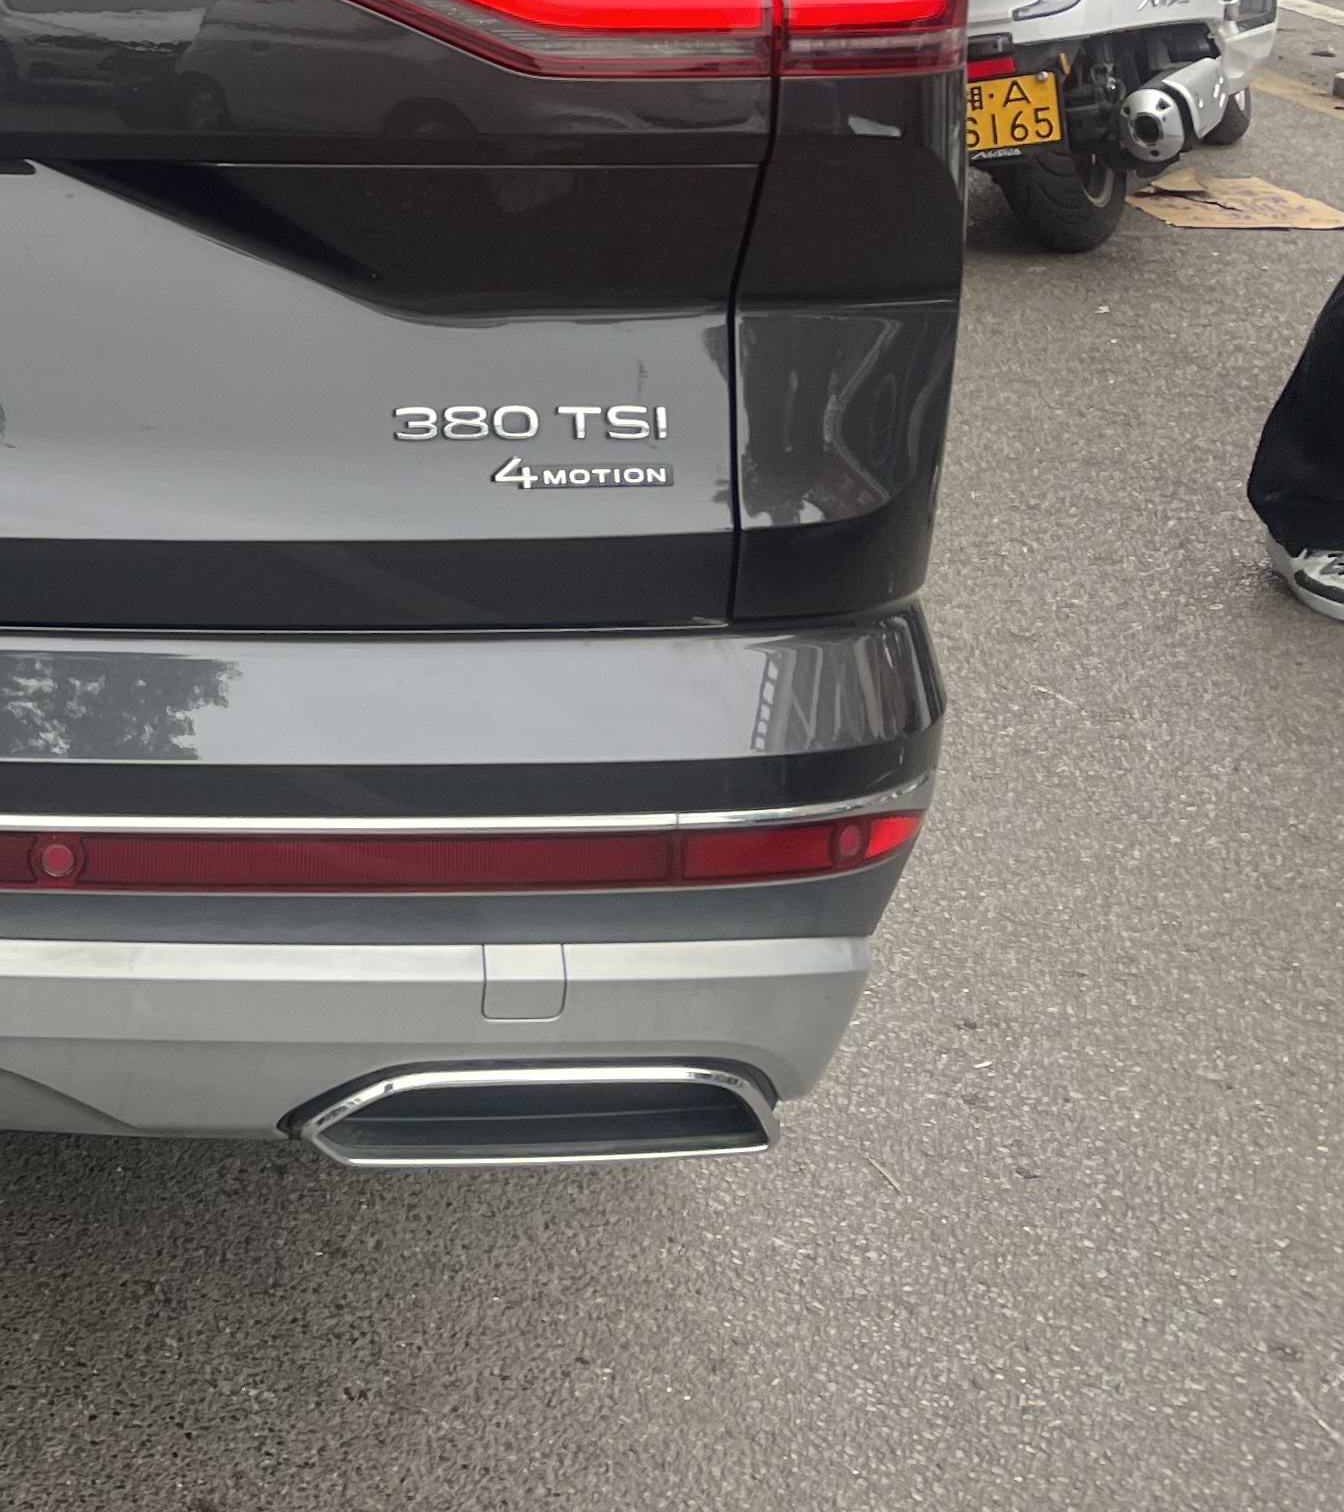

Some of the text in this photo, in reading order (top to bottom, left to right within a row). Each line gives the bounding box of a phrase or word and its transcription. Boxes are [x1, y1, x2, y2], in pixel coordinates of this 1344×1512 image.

[392, 404, 668, 440] 380 TSI
[489, 455, 668, 490] 4MOTION
